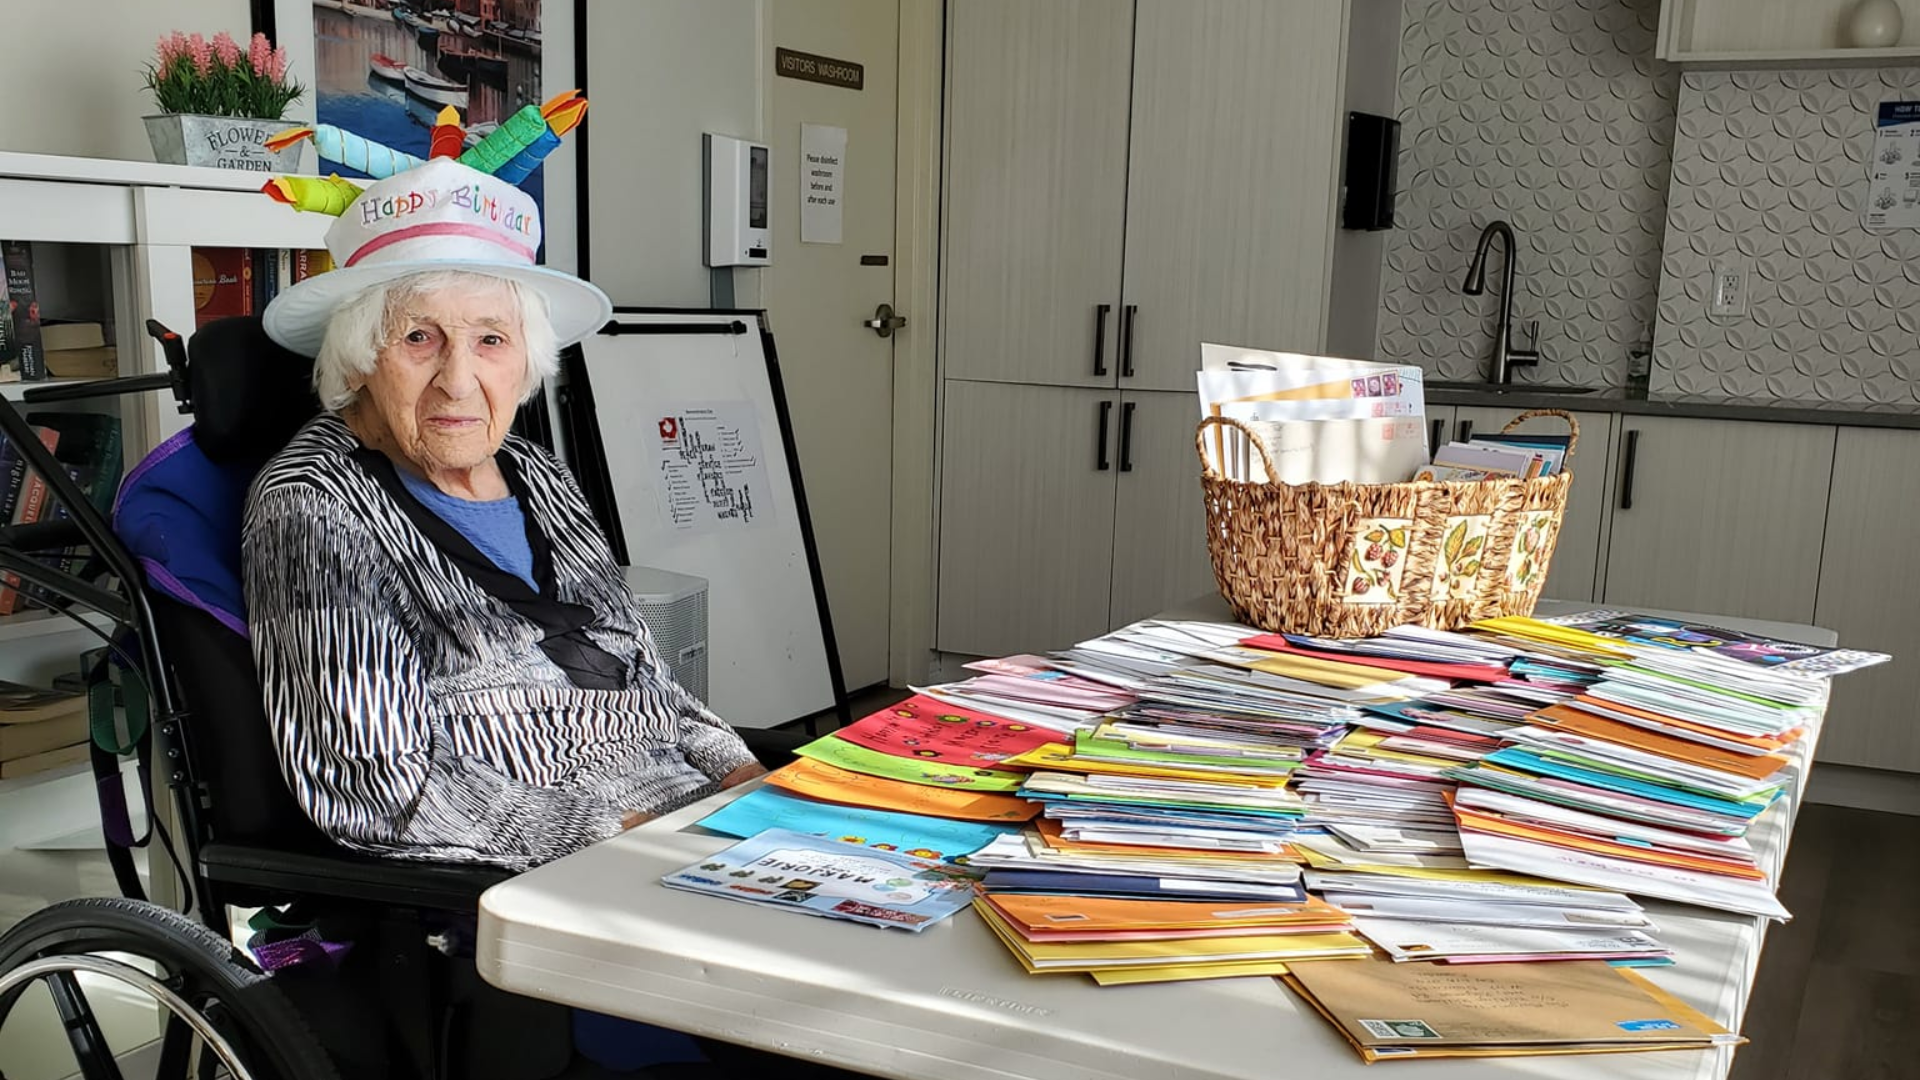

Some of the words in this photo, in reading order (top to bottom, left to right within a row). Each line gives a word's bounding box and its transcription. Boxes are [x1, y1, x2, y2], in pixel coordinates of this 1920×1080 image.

[781, 54, 816, 74] VISITORS
[818, 63, 860, 82] WASHROOM
[205, 127, 280, 155] FLOWE
[217, 158, 272, 172] GARDEN
[361, 191, 438, 225] Happy
[758, 857, 876, 884] MARJORIE
